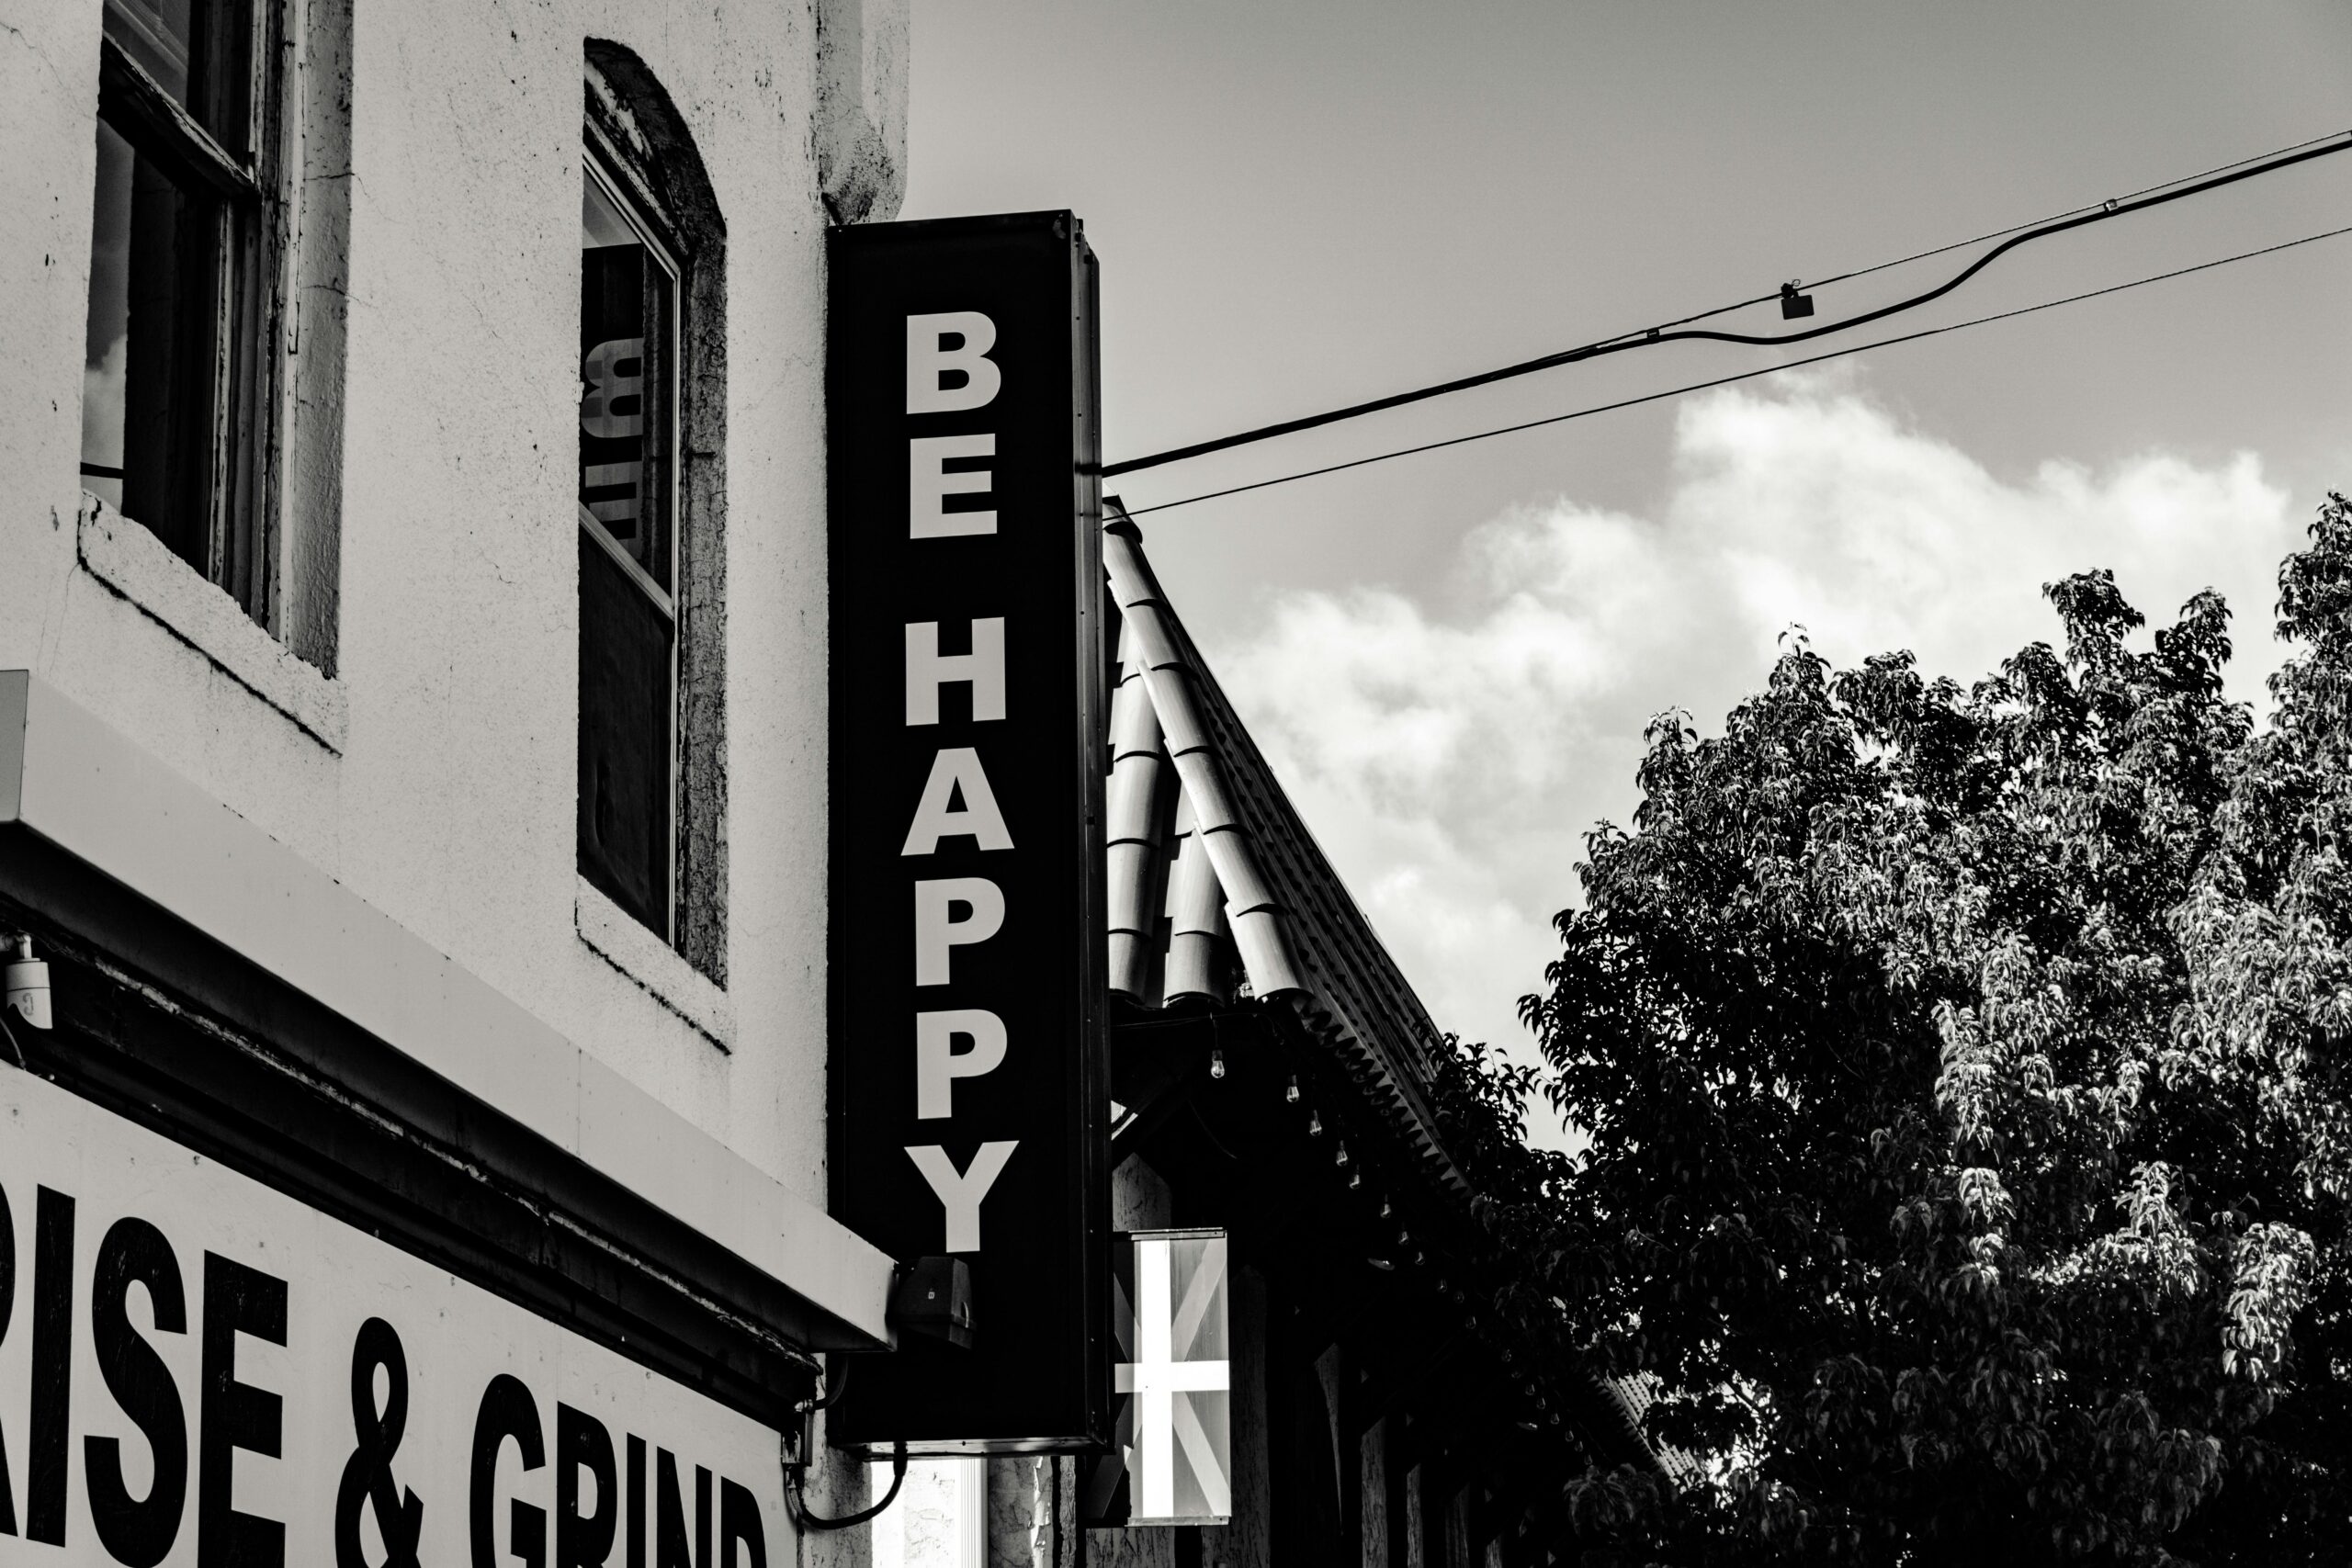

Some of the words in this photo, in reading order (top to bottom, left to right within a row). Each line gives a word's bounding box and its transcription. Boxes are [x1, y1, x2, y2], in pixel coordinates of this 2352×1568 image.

[907, 311, 1001, 539] BE
[901, 617, 1019, 1253] HAPPY
[0, 1182, 288, 1568] ISE
[335, 1317, 424, 1568] &
